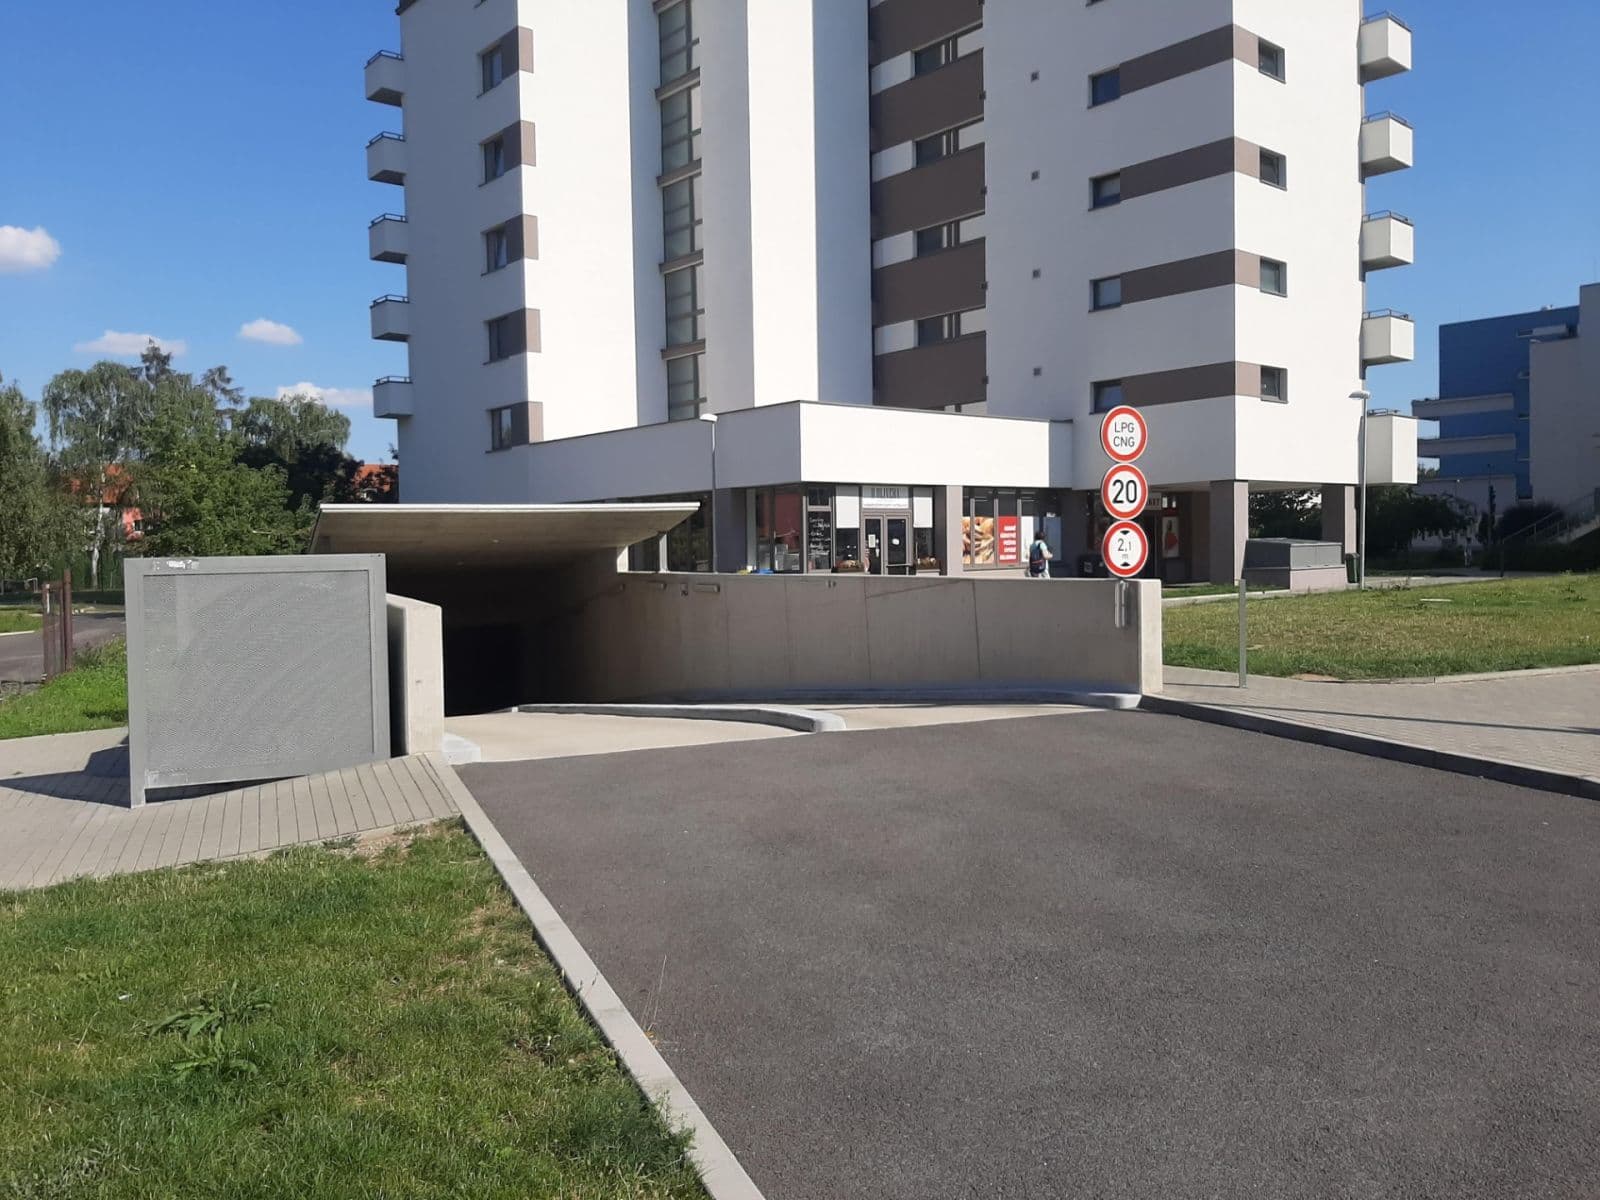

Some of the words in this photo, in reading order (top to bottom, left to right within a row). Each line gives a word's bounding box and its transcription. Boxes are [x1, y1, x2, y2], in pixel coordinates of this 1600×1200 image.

[1114, 422, 1135, 433] LPG
[1113, 436, 1135, 448] CNG
[1112, 479, 1138, 504] 20
